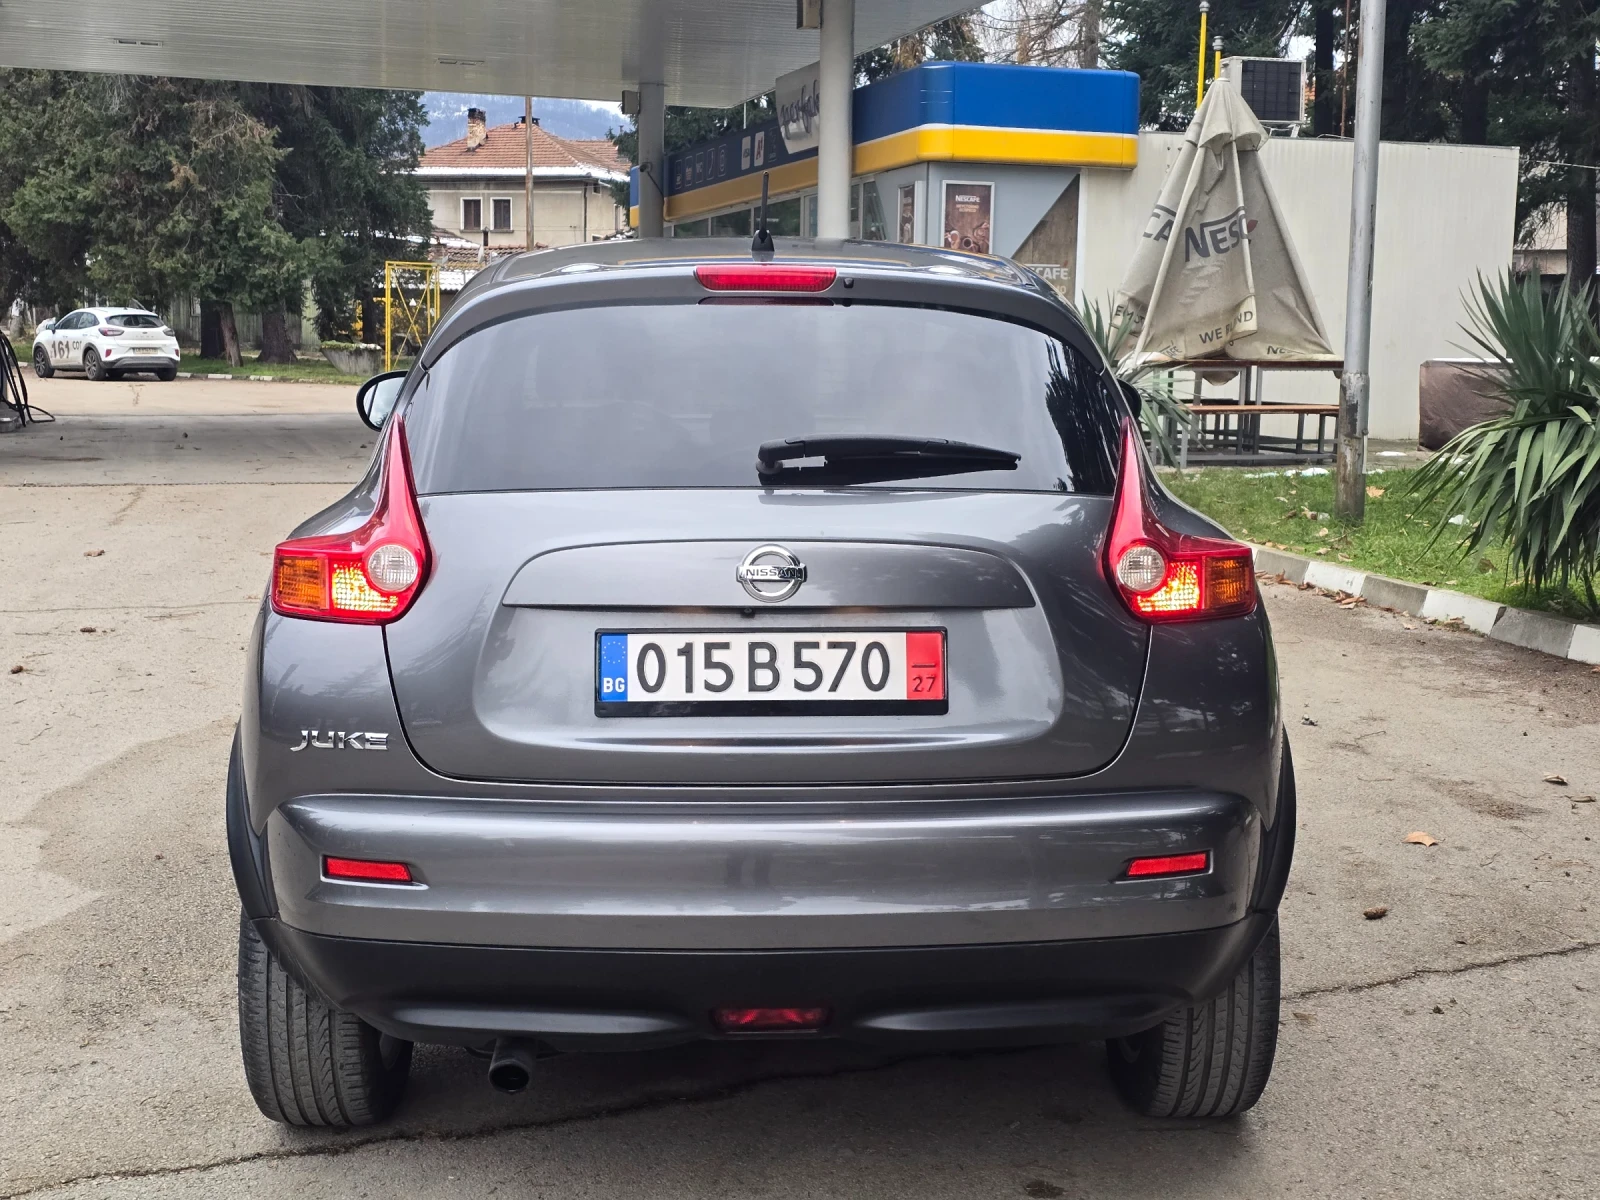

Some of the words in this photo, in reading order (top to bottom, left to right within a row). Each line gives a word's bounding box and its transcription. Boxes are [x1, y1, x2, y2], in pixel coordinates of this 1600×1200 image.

[1199, 327, 1223, 344] WE
[51, 341, 70, 359] 161
[746, 567, 797, 578] NISSAN
[603, 677, 626, 693] BG
[912, 675, 937, 693] 27
[290, 730, 389, 752] JUKE
